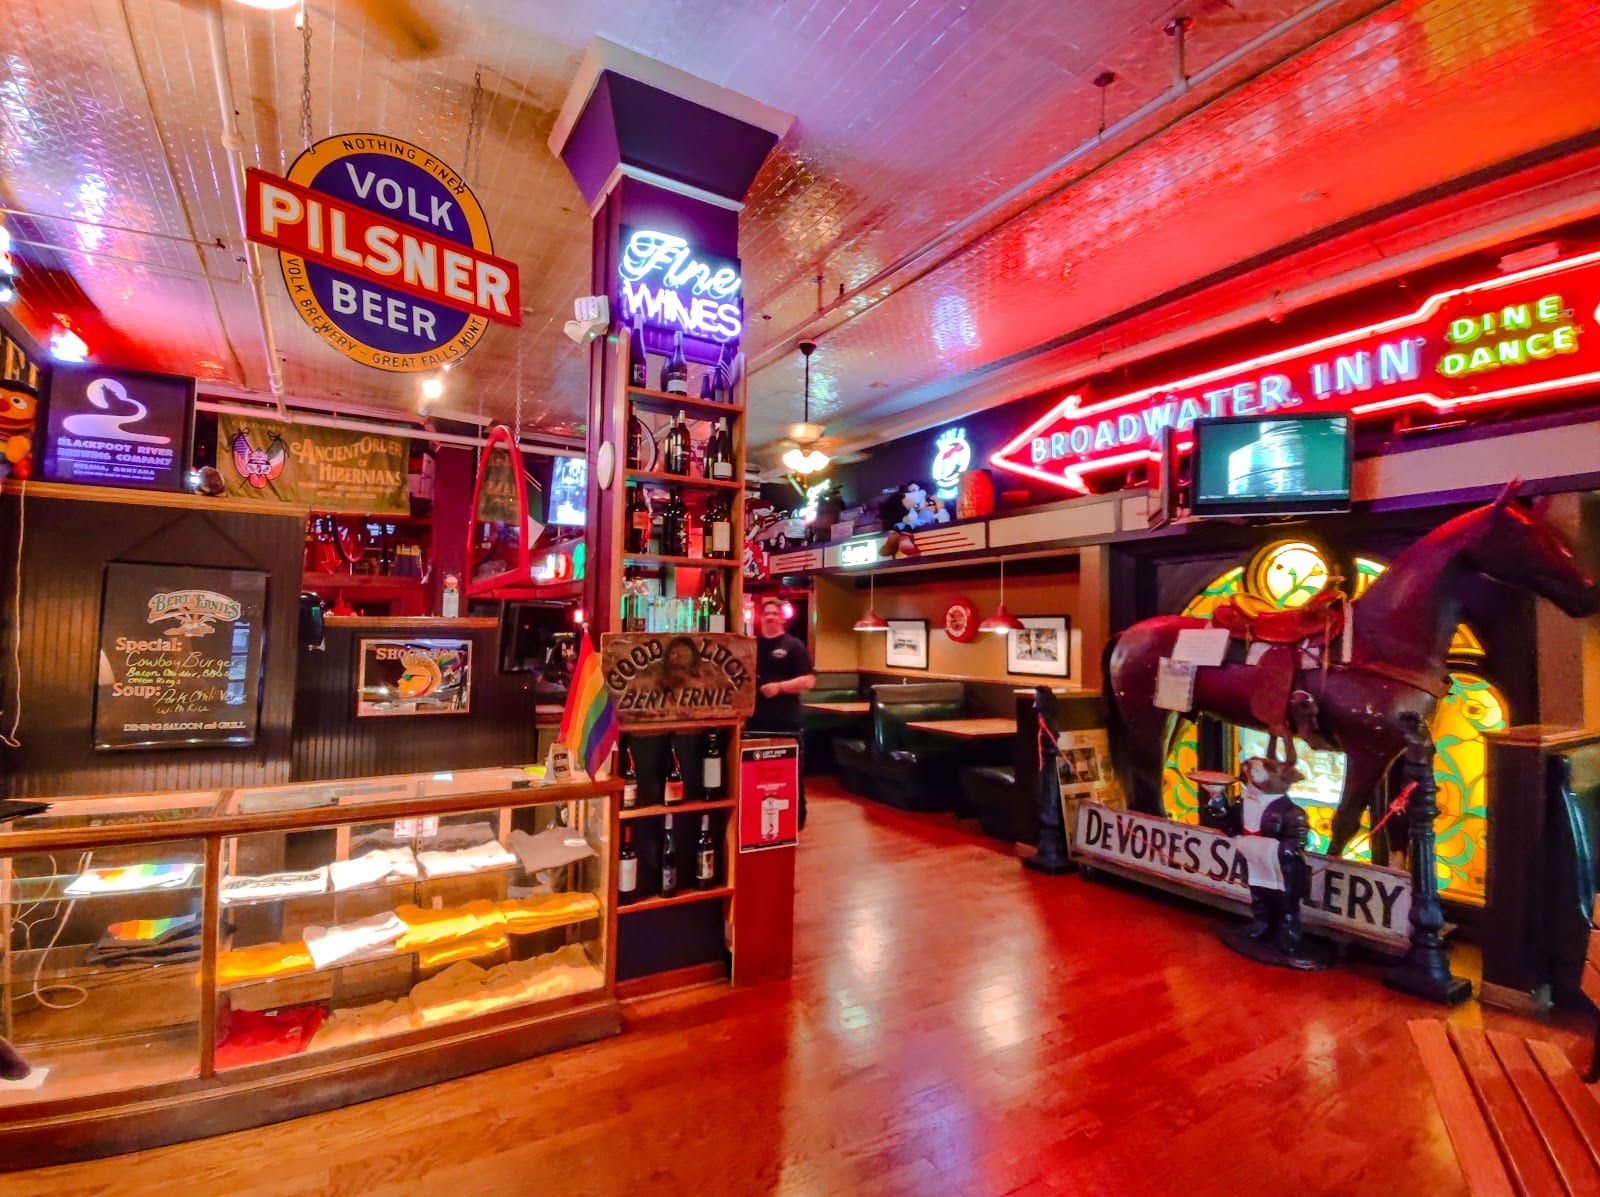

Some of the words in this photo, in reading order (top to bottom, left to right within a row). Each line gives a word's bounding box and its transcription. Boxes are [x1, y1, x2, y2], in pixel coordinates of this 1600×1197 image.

[342, 138, 417, 160] NOTHING
[424, 158, 465, 195] FINER
[345, 162, 454, 231] VOLK
[260, 182, 511, 316] PILSNER
[618, 230, 742, 297] Fine
[287, 258, 308, 294] VOLK
[300, 299, 356, 351] BREWERY
[372, 353, 416, 369] GREAT
[421, 345, 460, 367] FALLS
[331, 279, 438, 342] BEER
[621, 279, 742, 338] WINES
[1449, 294, 1563, 343] DINE
[1312, 339, 1418, 398] INN
[1440, 325, 1578, 377] DANCE
[57, 437, 132, 453] BLACKFOOT
[137, 446, 174, 457] RIVER
[115, 454, 173, 466] COMPANY
[290, 438, 360, 465] ANCIENT
[359, 436, 403, 458] ORDER
[320, 463, 402, 486] HIBERNIANS
[152, 593, 191, 612] BERT
[115, 636, 183, 653] Special:
[181, 651, 239, 671] Burger
[606, 638, 664, 692] GOOD
[700, 637, 752, 691] LUCK
[112, 682, 162, 698] Soup:
[619, 687, 671, 711] BERT
[677, 687, 735, 709] ERNIE
[162, 722, 204, 731] SALOON
[1208, 838, 1405, 929] SALERY
